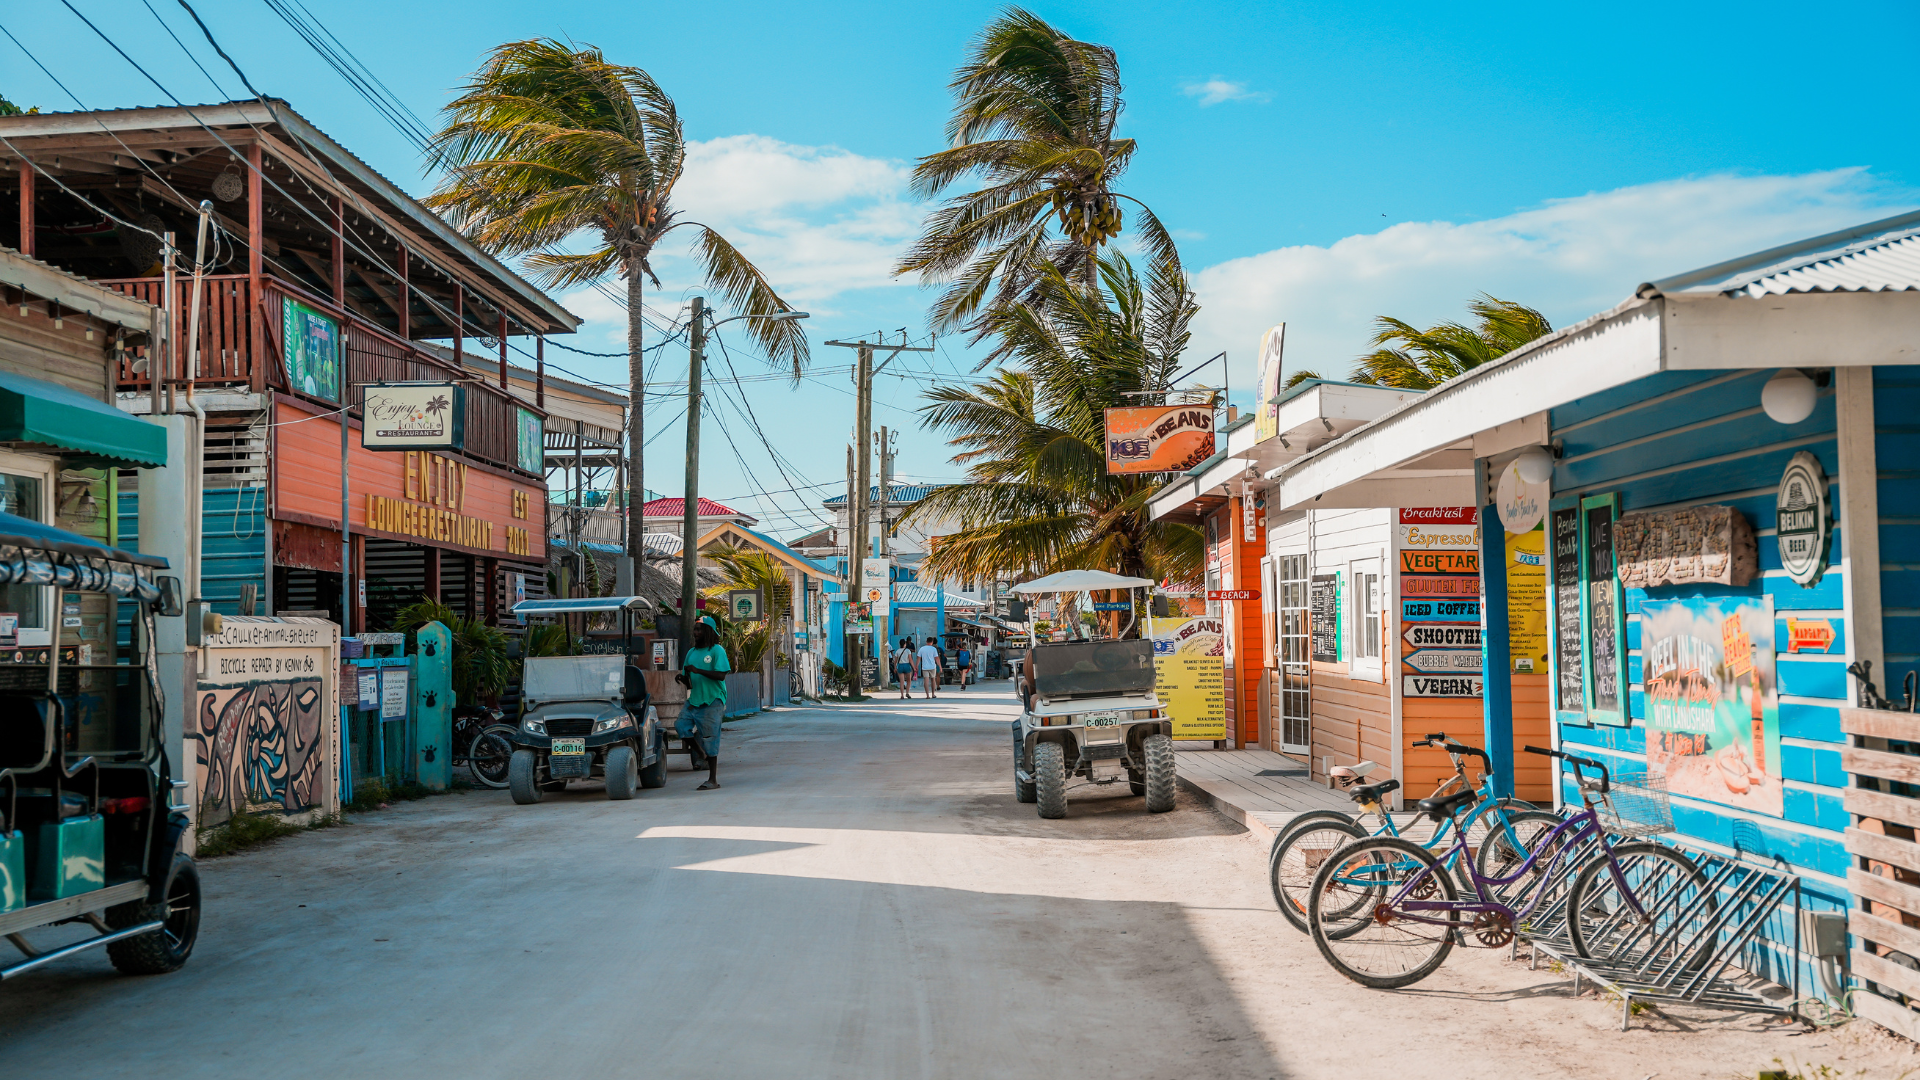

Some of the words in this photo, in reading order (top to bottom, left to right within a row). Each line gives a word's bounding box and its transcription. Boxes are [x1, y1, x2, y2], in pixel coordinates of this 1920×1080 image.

[284, 295, 293, 386] IGHTHOUSE
[367, 394, 417, 420] Enjoy
[399, 420, 436, 430] LOUNGE
[1110, 439, 1151, 460] ICE
[1155, 410, 1212, 439] BEANS
[405, 450, 467, 512] ENJOY
[511, 488, 530, 521] EST
[1244, 481, 1256, 542] CAFE
[1403, 507, 1464, 519] Breakfast
[1780, 511, 1815, 532] BELIKIN
[506, 525, 531, 557] 2011
[1408, 527, 1471, 548] Espresso
[1789, 540, 1807, 552] BEER
[1220, 590, 1250, 600] BEACH
[1407, 580, 1457, 593] GLUTEN
[1405, 604, 1431, 616] ICED
[1153, 639, 1176, 655] CE
[1179, 620, 1223, 640] BEANS
[220, 657, 247, 674] BICYCLE
[251, 656, 274, 673] REPAIR
[275, 658, 283, 673] BY
[284, 658, 303, 673] KENNY
[1418, 655, 1448, 667] BUBBLE
[1651, 636, 1676, 680] REEL
[1677, 635, 1690, 669] IN
[1691, 636, 1715, 684] THE
[1413, 678, 1473, 695] VEGAN
[455, 718, 467, 731] 17
[1086, 717, 1118, 728] C-00257
[1654, 704, 1672, 728] WITH
[1672, 706, 1716, 733] LANDSHARK
[554, 745, 583, 753] C-00116
